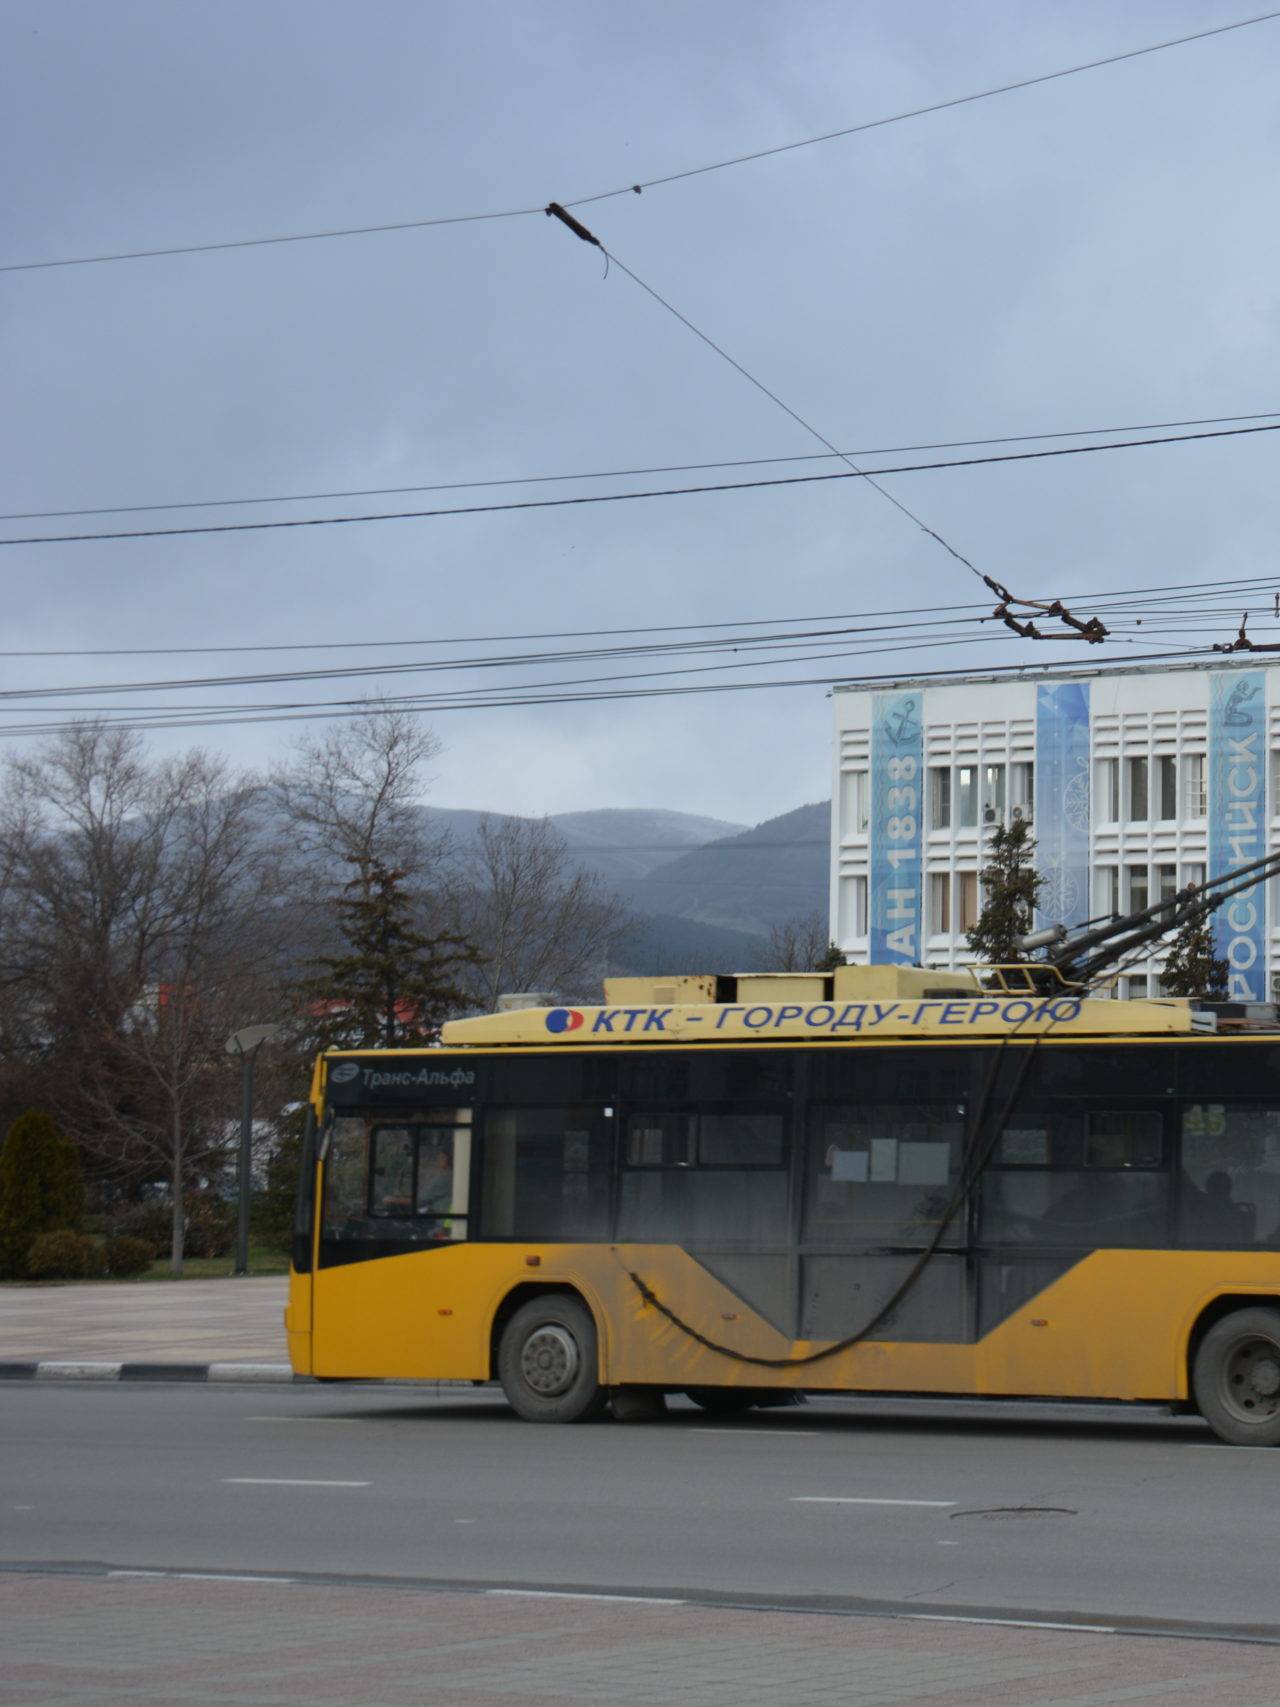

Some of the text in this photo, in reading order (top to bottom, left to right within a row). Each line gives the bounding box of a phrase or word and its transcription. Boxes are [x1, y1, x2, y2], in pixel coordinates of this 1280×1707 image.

[886, 755, 917, 966] АН 1838
[592, 1008, 673, 1033] КТК
[715, 999, 1082, 1032] ГОРОДУ-ГЕРОЮ
[363, 1068, 476, 1089] Транс-Альфа
